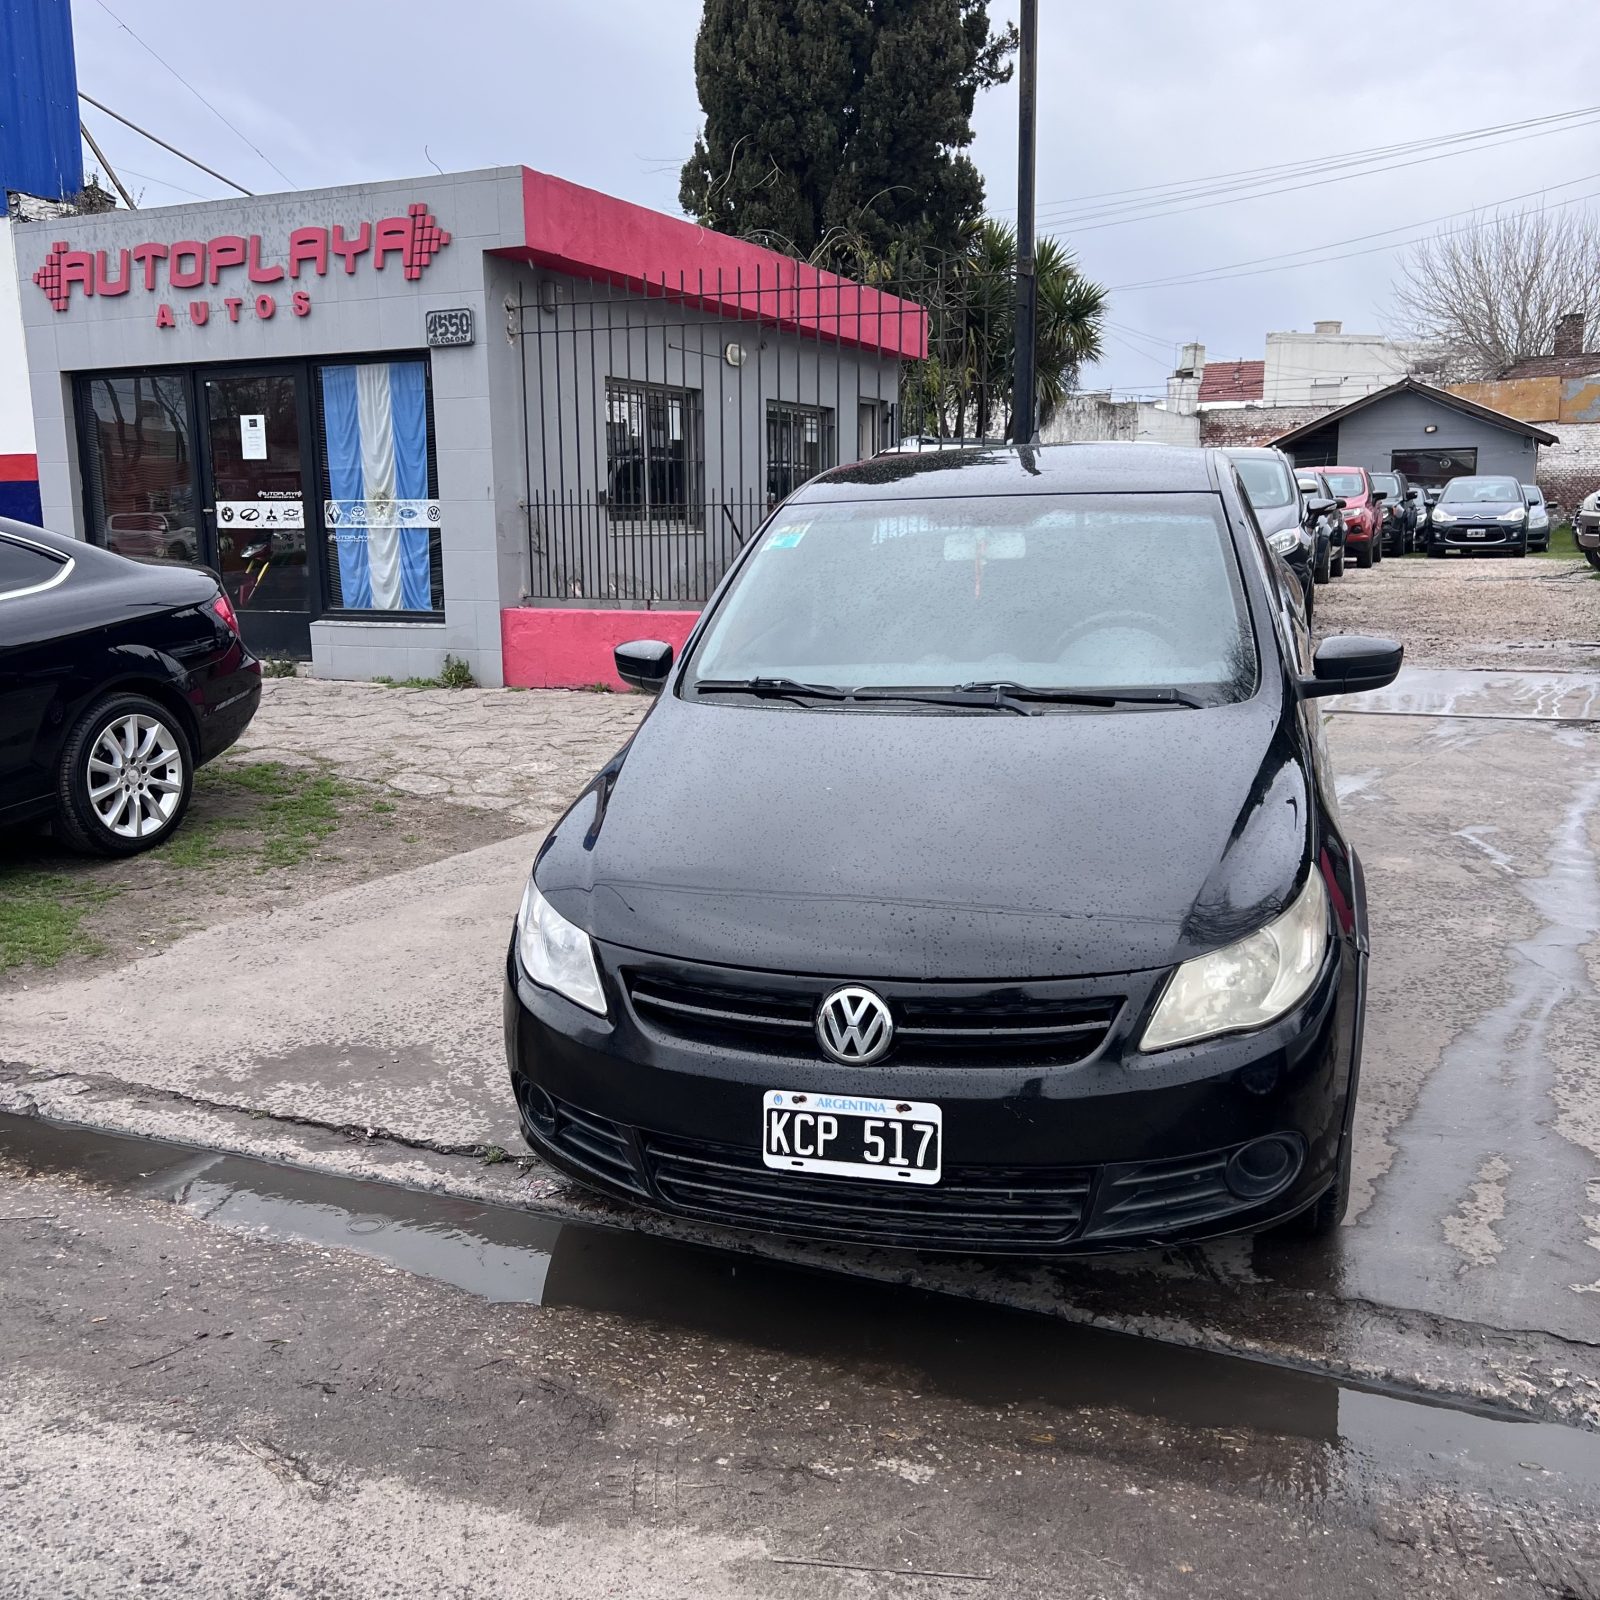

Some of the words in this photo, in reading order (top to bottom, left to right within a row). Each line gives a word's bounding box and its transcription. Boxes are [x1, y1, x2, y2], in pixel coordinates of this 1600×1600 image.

[60, 216, 412, 297] AUTOPLAYA
[156, 291, 311, 328] AUTOS
[429, 313, 470, 337] 4550
[817, 1097, 887, 1113] ARGENTINA
[771, 1111, 838, 1157] KCP
[863, 1119, 934, 1167] 517
